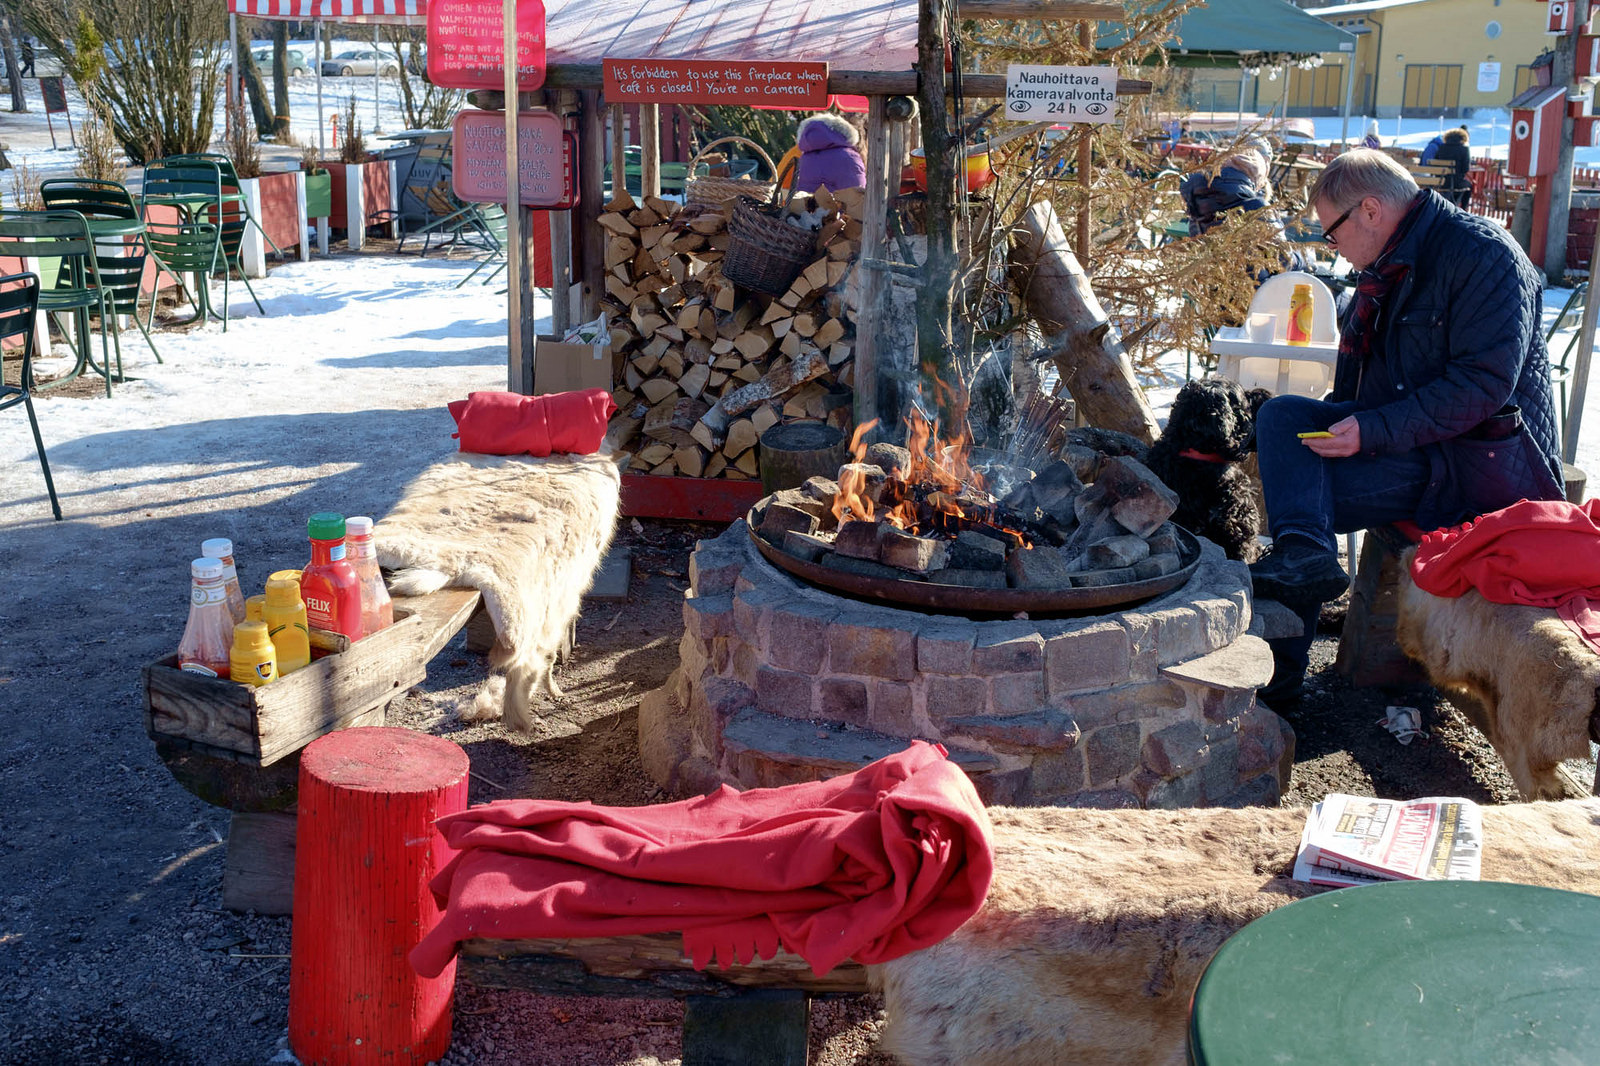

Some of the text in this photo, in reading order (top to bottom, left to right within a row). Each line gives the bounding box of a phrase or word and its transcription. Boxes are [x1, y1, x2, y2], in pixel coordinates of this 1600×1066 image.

[631, 65, 679, 80] forbidden
[687, 68, 700, 80] to
[702, 69, 719, 80] use
[725, 67, 742, 80] this
[749, 67, 792, 83] fireplace
[797, 69, 823, 81] when
[1020, 72, 1099, 85] Nauhoittava
[646, 81, 656, 93] is
[744, 85, 758, 94] on
[1007, 87, 1114, 101] kameravalvonta
[1047, 102, 1076, 114] 24 h
[307, 597, 330, 612] FELIX
